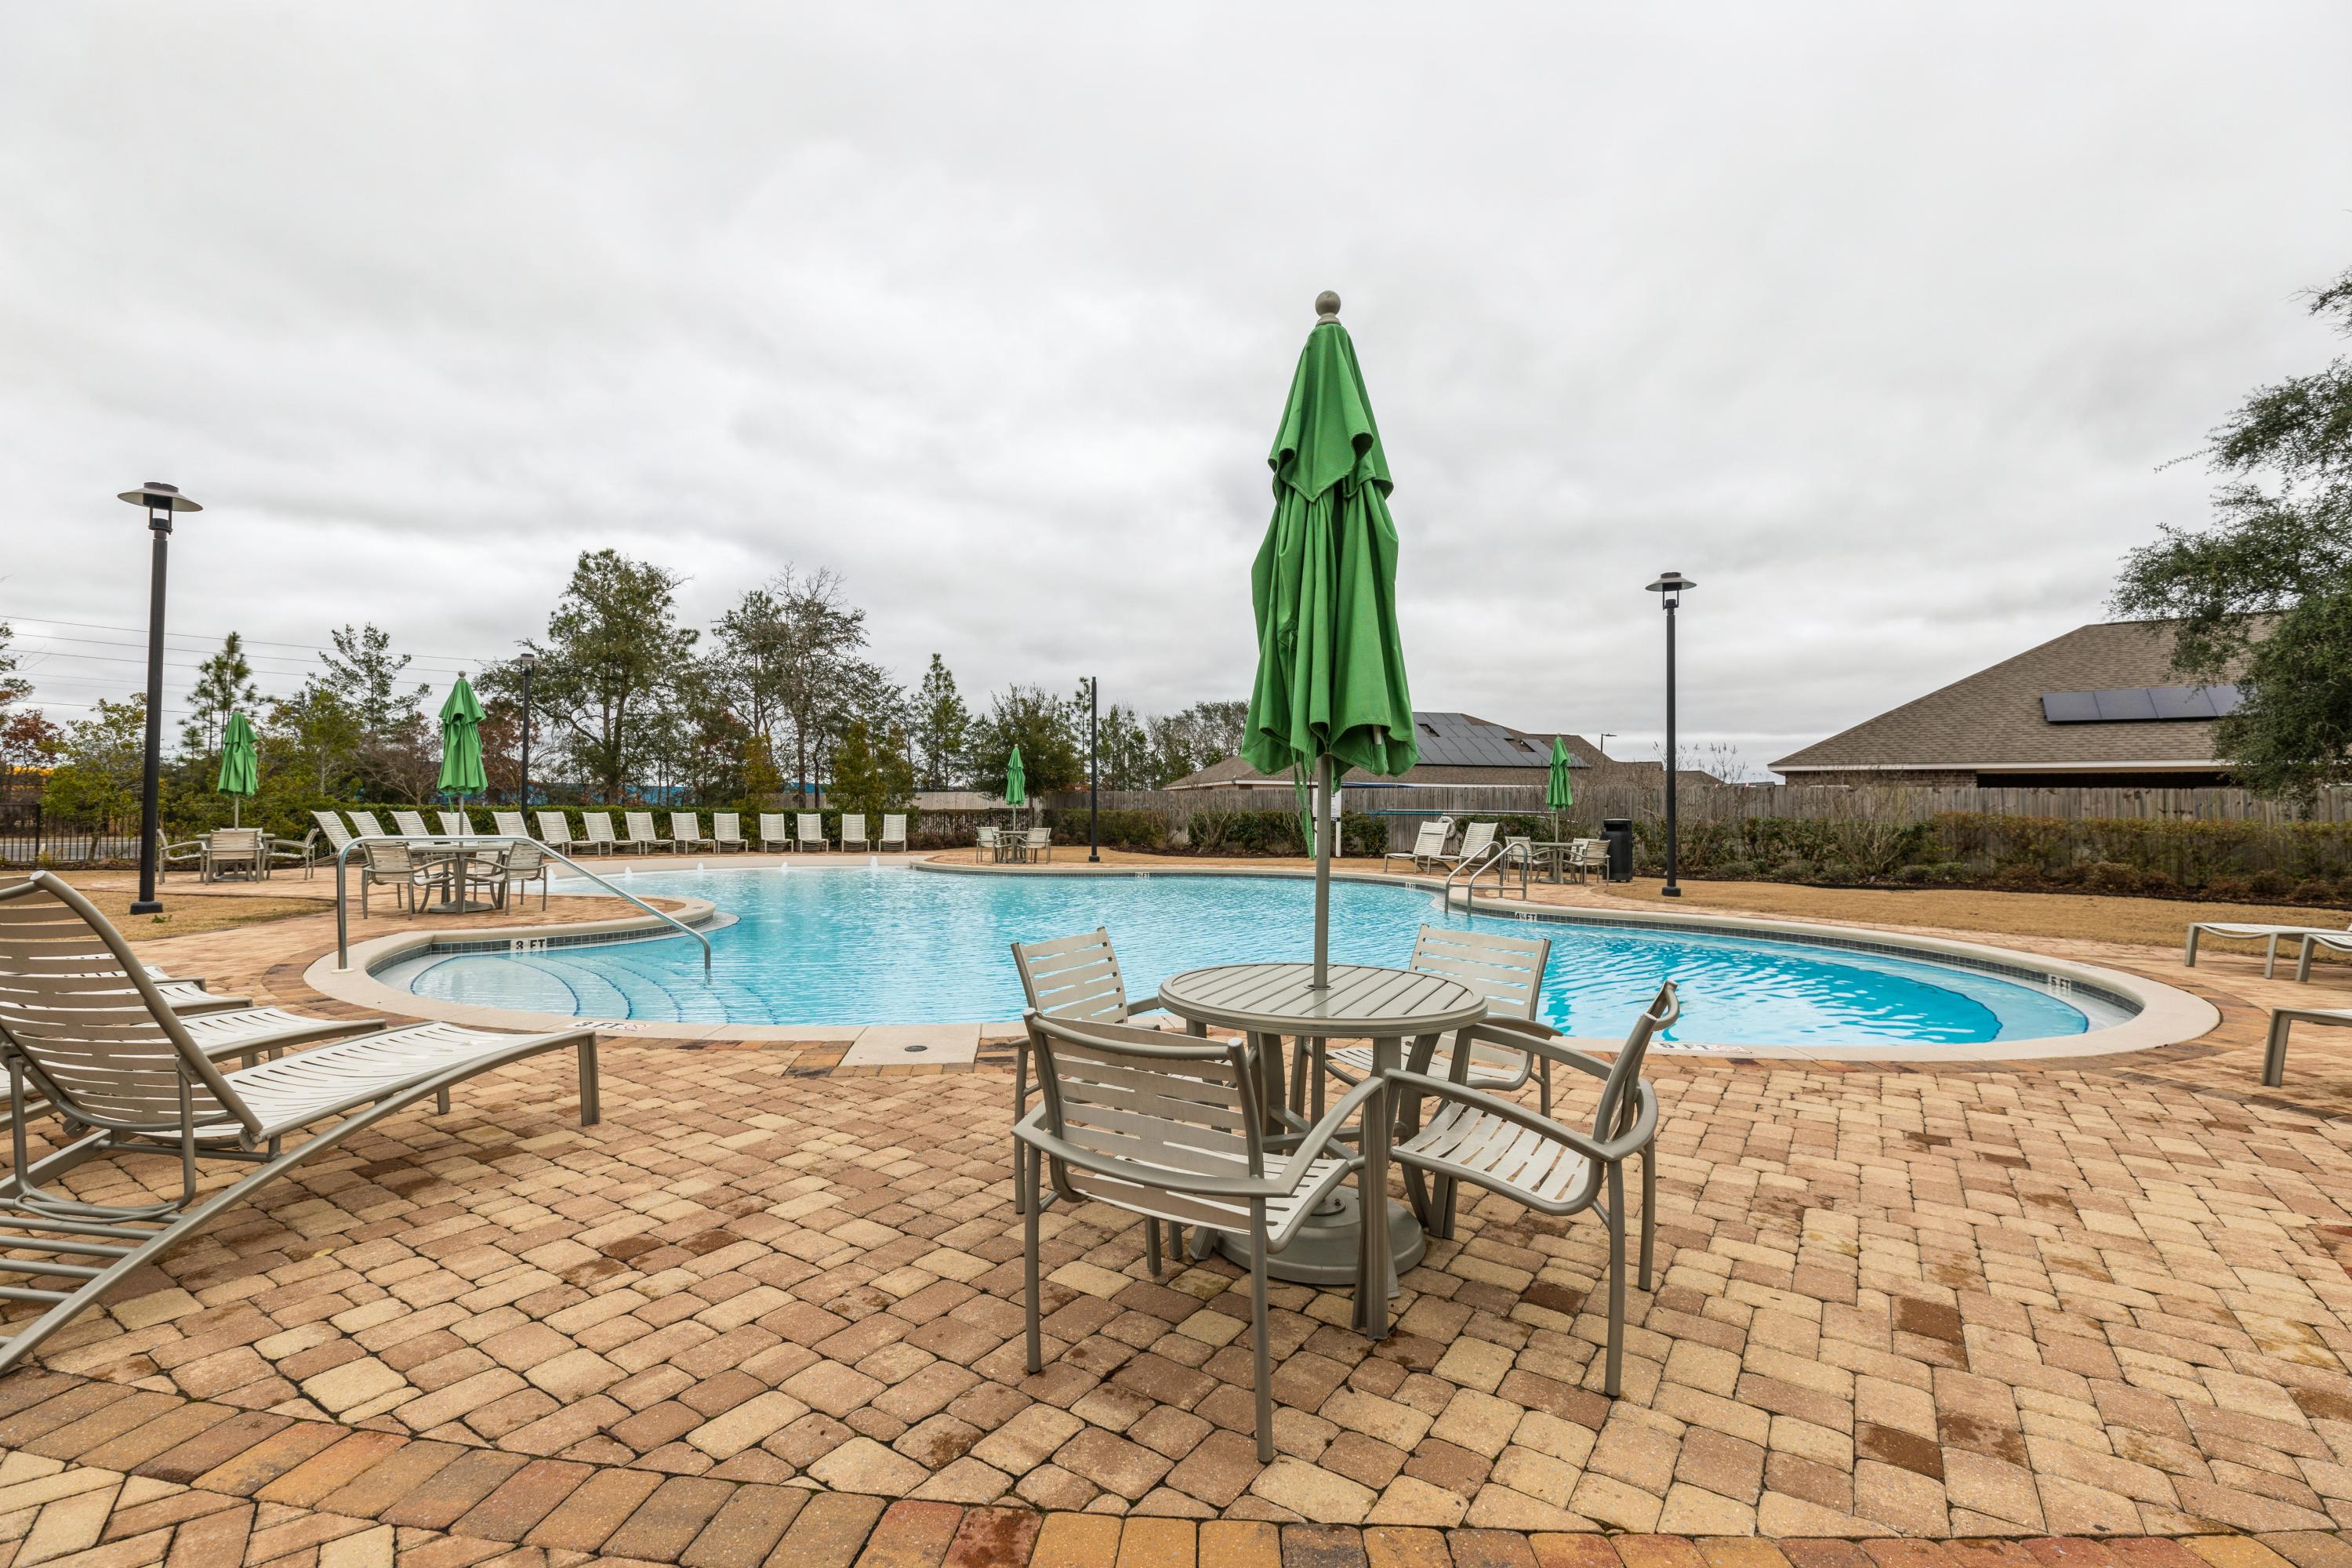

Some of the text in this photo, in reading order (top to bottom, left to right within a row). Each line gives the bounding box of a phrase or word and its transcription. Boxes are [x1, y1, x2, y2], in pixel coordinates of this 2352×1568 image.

[516, 938, 546, 949] 3 FT
[2060, 978, 2070, 989] FT
